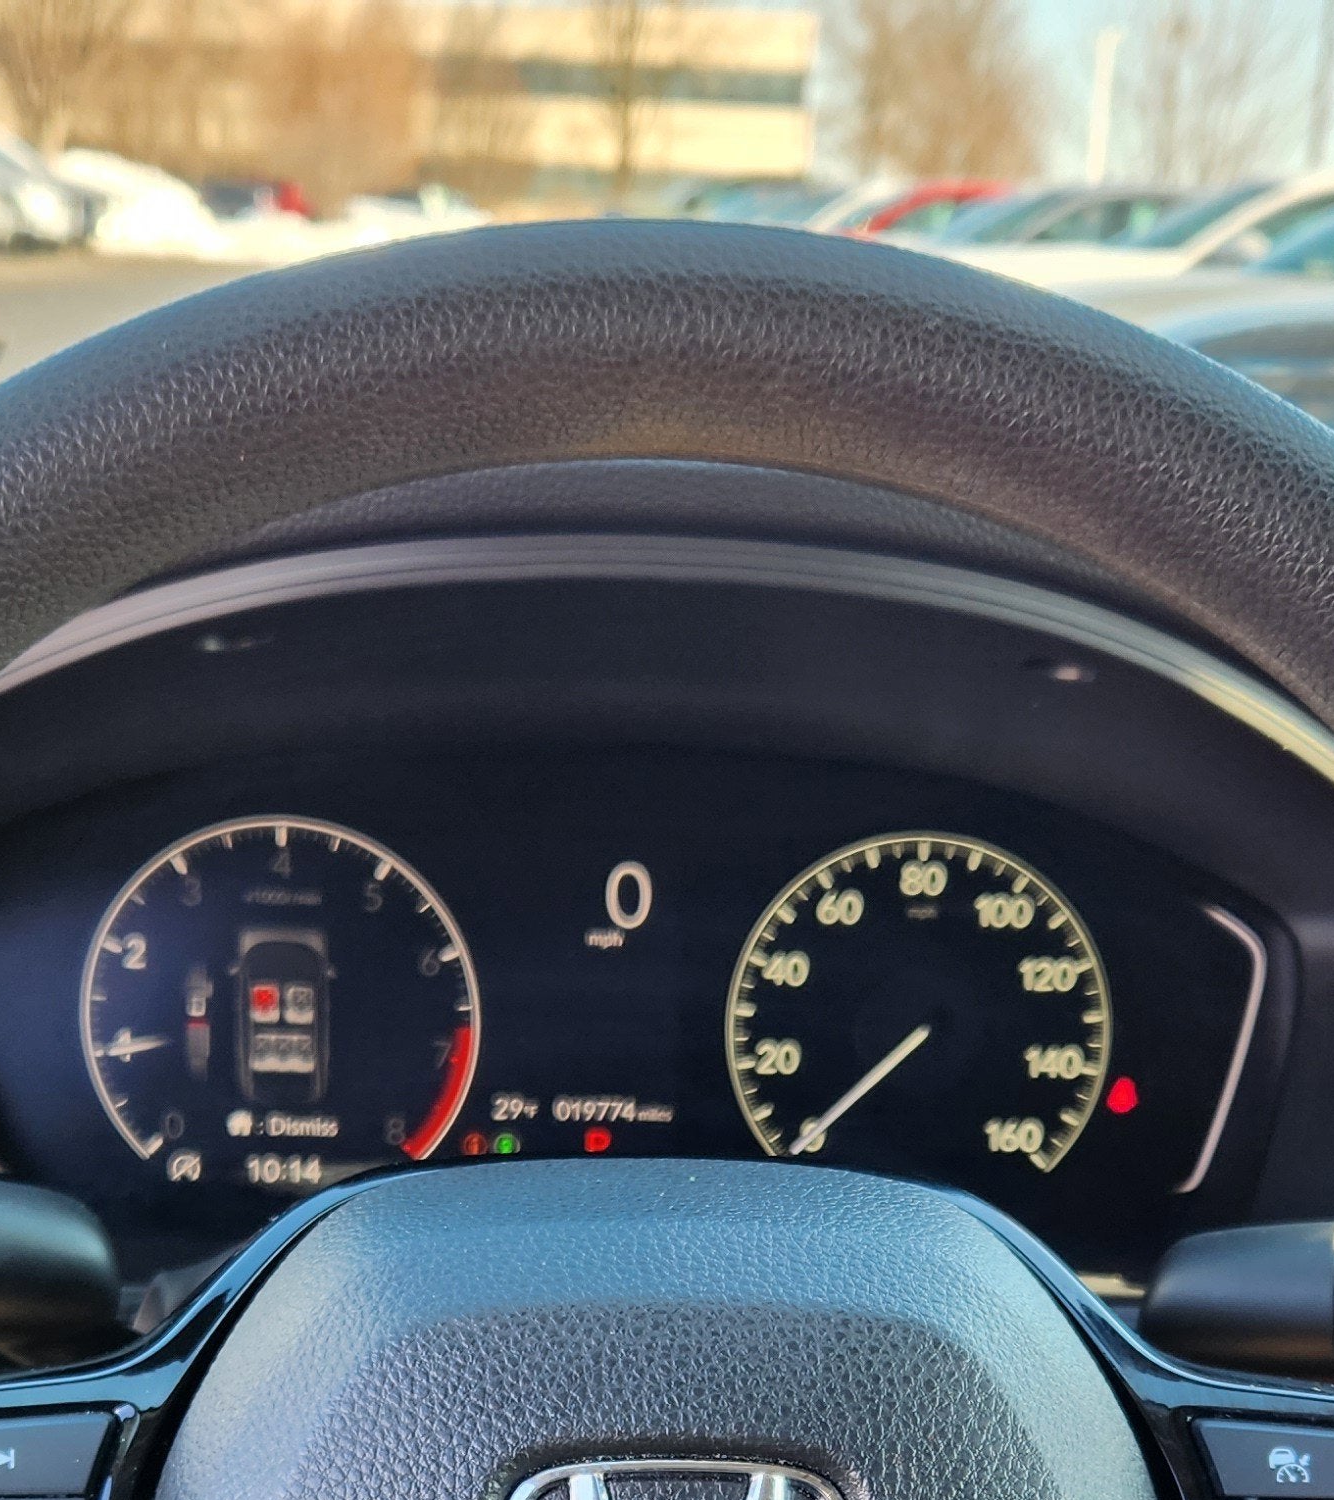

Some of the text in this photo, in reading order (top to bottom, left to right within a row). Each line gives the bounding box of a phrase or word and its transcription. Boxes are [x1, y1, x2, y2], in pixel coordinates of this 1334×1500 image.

[605, 861, 653, 930] 0
[899, 861, 948, 896] 80
[816, 890, 864, 926] 60
[974, 893, 1034, 928] 100
[122, 934, 147, 969] 2
[762, 951, 810, 986] 40
[1019, 956, 1079, 992] 120
[755, 1039, 801, 1075] 20
[1025, 1044, 1085, 1079] 140
[269, 1112, 338, 1137] Dismiss
[553, 1095, 636, 1122] 019774
[984, 1118, 1045, 1153] 160
[246, 1155, 323, 1184] 10:14
